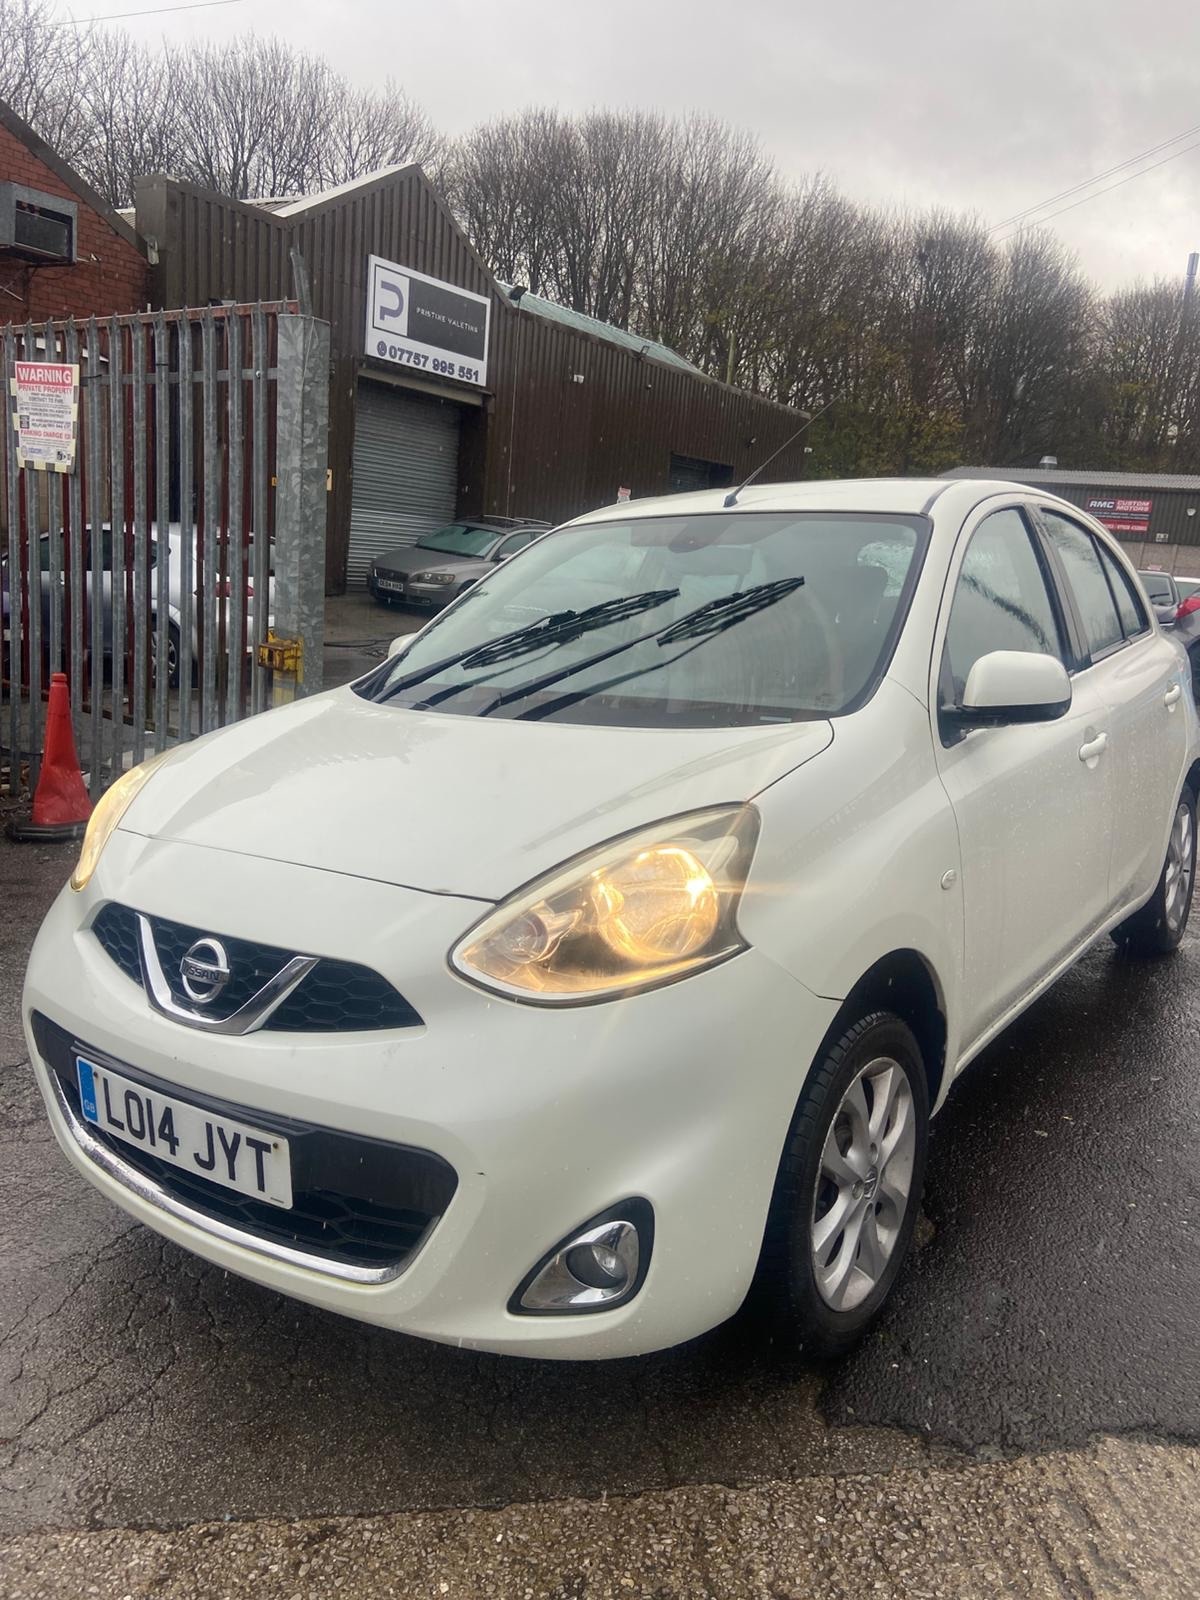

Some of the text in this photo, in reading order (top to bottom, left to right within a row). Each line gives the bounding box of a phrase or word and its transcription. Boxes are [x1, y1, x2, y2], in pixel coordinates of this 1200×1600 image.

[416, 307, 478, 333] PRISTINE VALETING
[389, 345, 479, 382] 07757 995 551
[18, 367, 72, 384] WARNING
[18, 384, 73, 394] PRIVATE PROPERTY
[1089, 500, 1115, 508] RMC
[83, 1099, 96, 1113] GB
[102, 1076, 272, 1193] LO14 JYT
